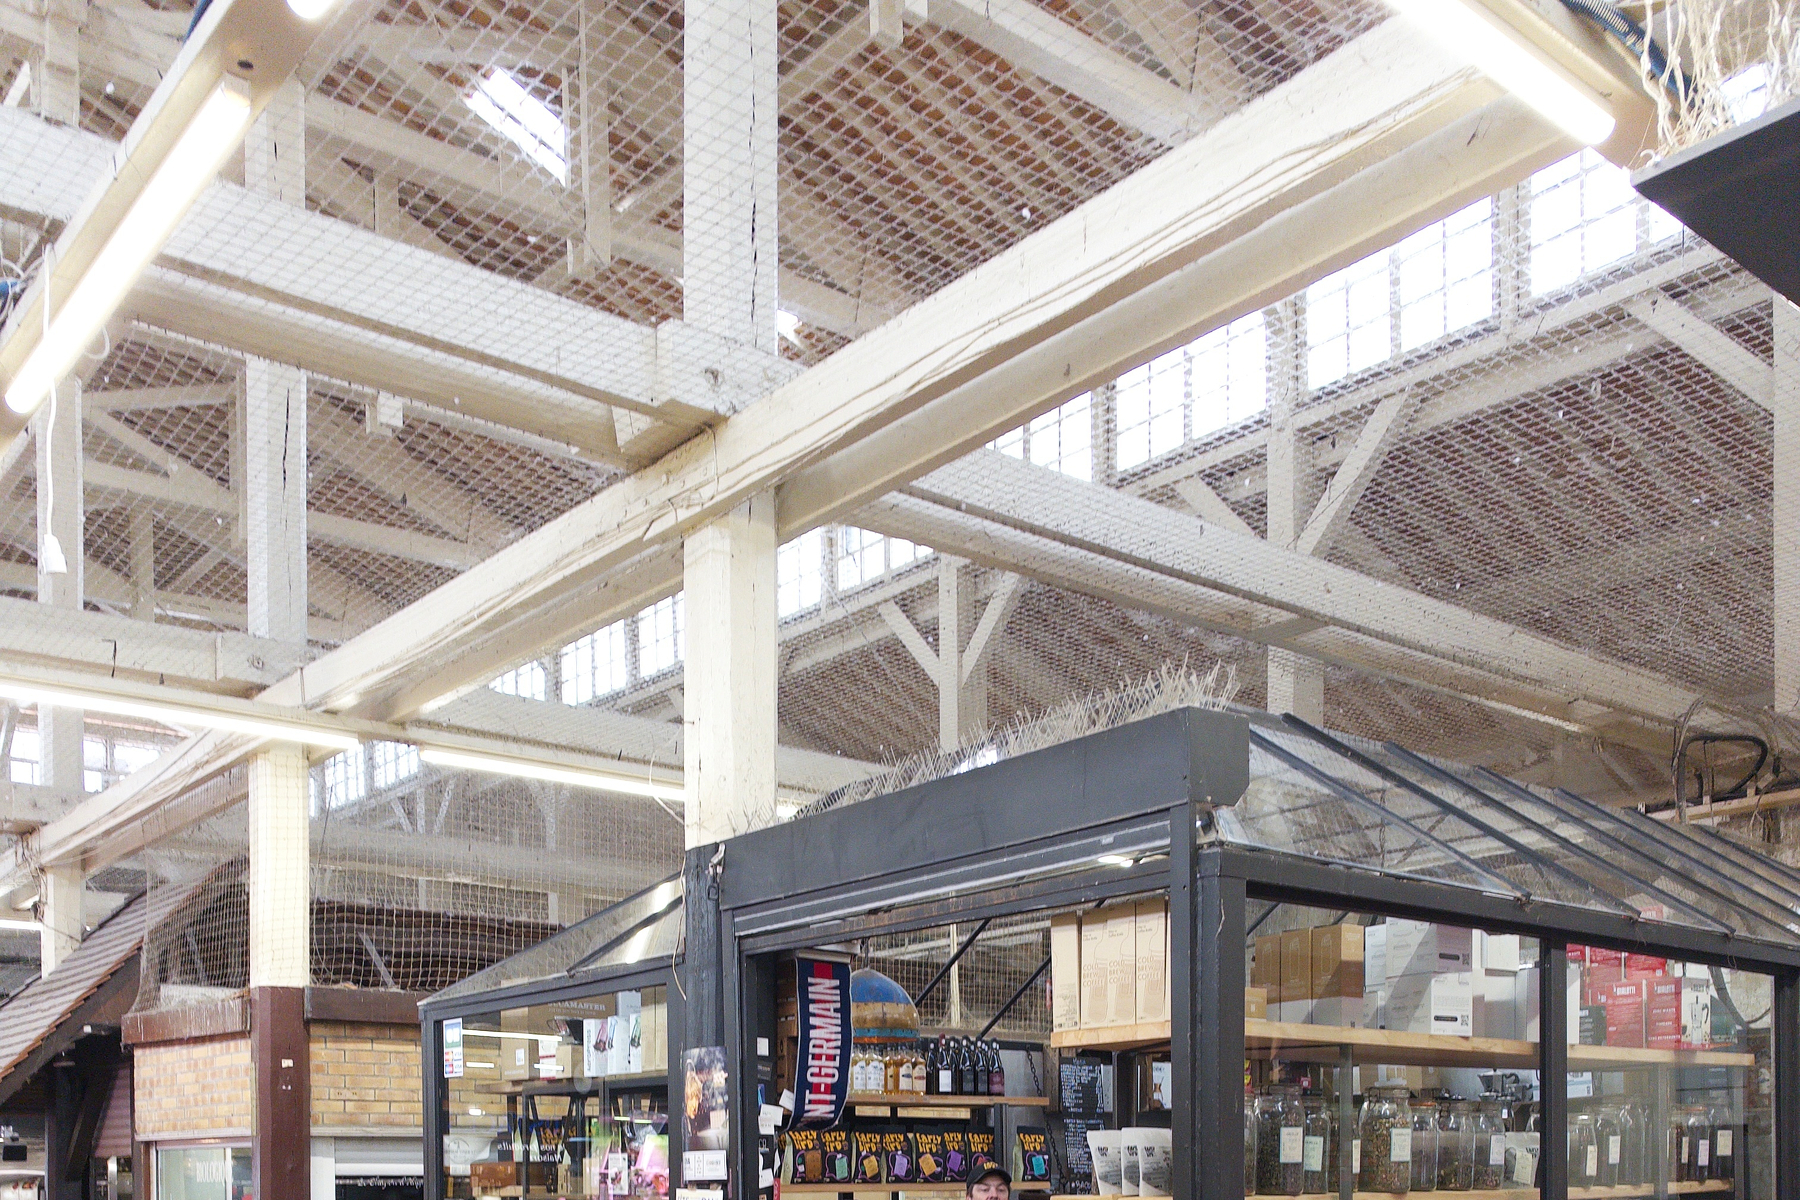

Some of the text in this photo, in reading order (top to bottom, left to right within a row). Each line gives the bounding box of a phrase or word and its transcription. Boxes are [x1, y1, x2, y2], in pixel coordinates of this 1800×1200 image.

[1109, 959, 1124, 968] COLD
[1138, 963, 1154, 972] BREW
[1083, 971, 1098, 979] BREW
[1109, 967, 1124, 975] BREW
[1109, 975, 1130, 984] COFFEE
[1138, 972, 1159, 981] COFFEE
[1083, 979, 1103, 987] COFFEE
